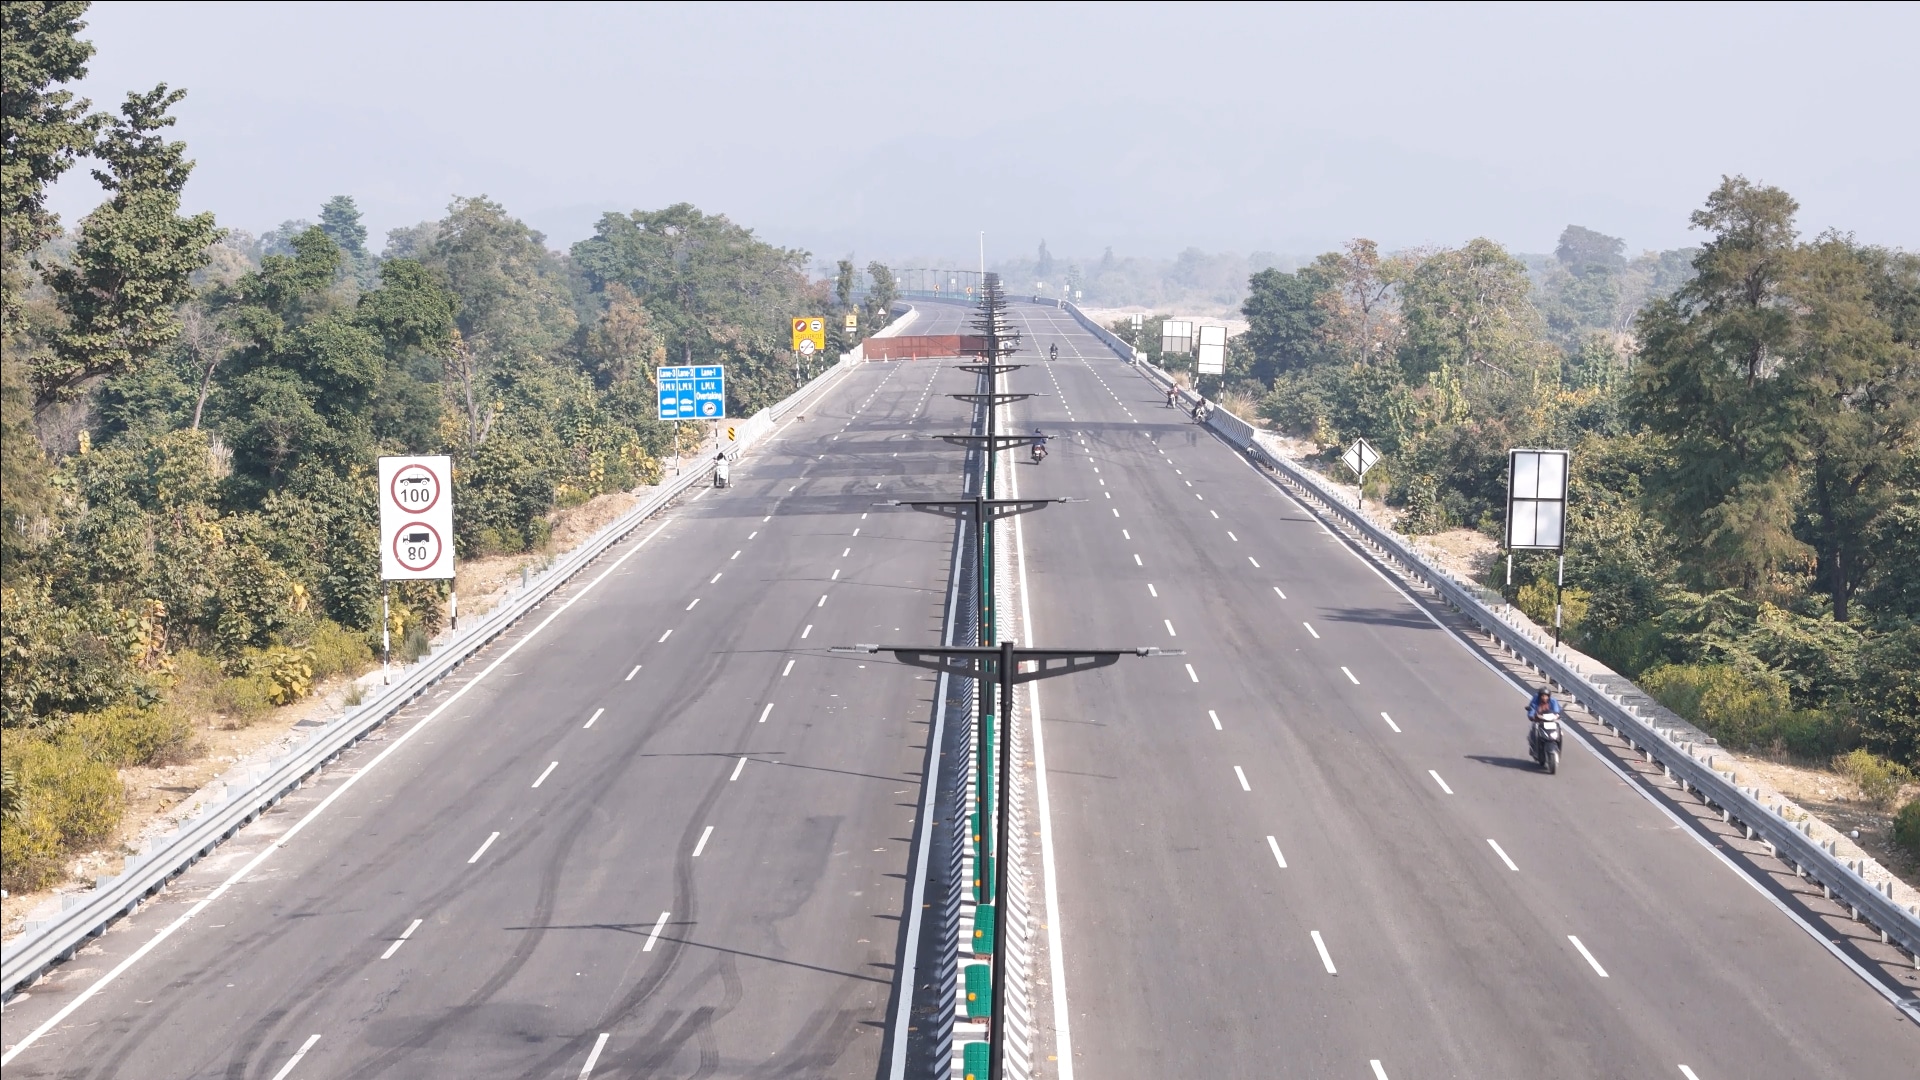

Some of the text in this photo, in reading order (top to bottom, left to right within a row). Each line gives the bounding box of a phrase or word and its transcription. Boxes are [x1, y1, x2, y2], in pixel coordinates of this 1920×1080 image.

[696, 391, 722, 401] Overtaking
[400, 488, 430, 502] 100
[408, 546, 427, 560] 80
